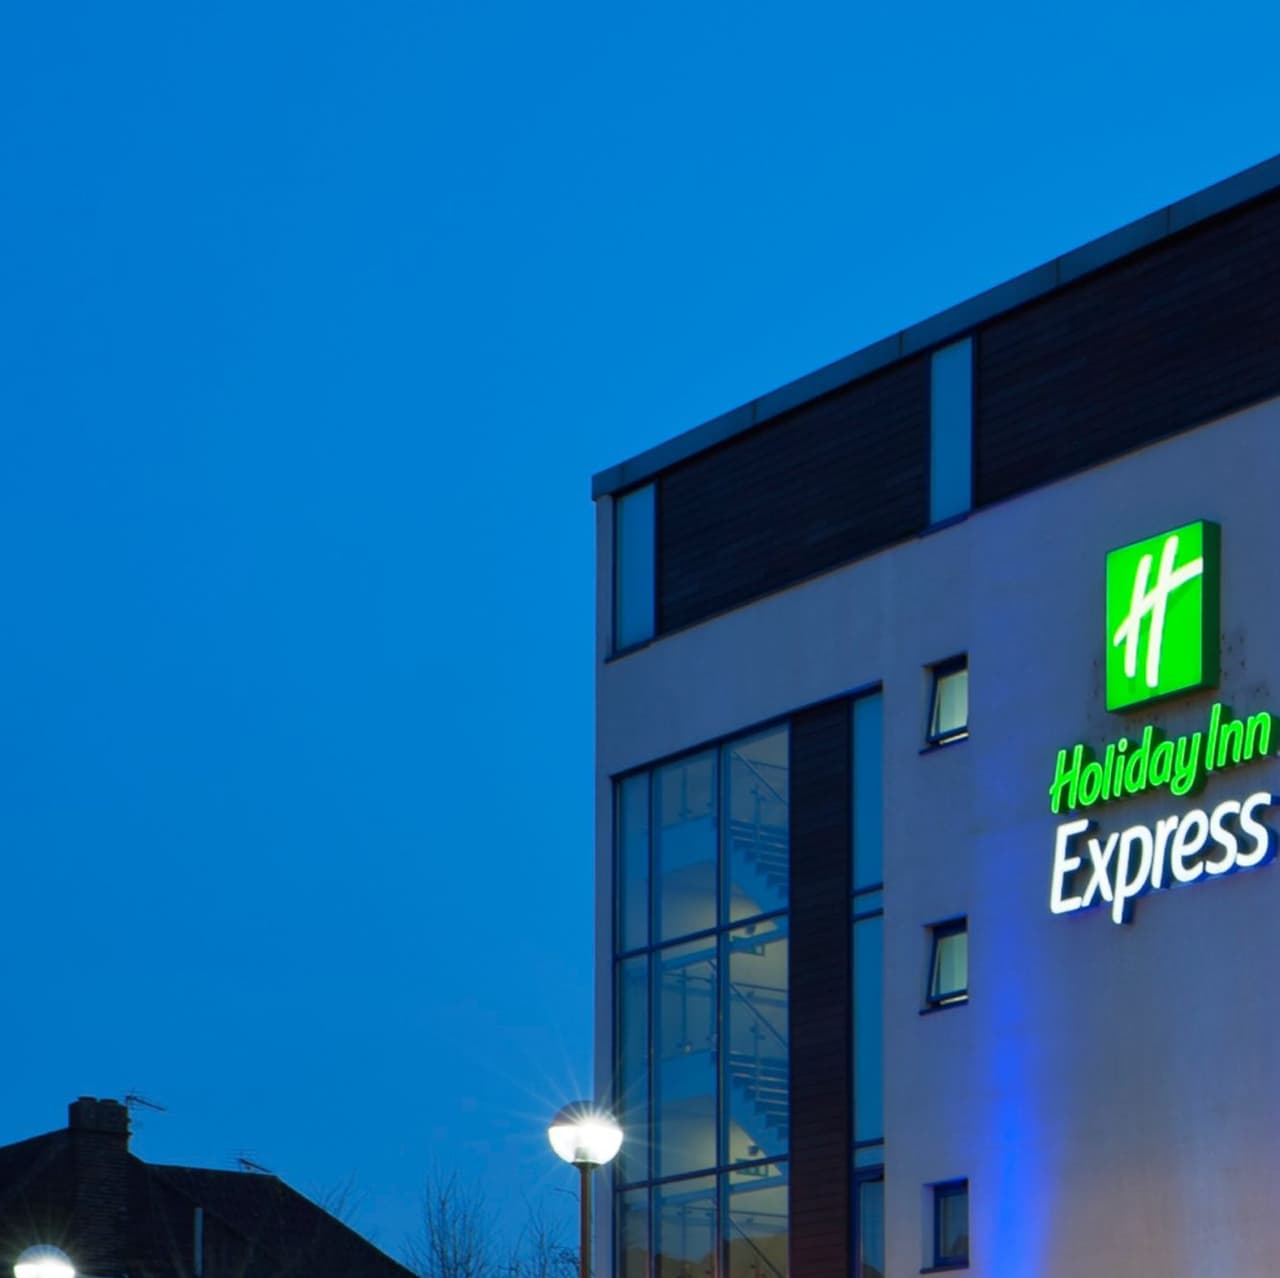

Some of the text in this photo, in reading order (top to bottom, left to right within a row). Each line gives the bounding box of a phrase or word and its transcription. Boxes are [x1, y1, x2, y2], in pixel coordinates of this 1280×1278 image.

[1050, 703, 1271, 814] Holiday Inn
[1050, 792, 1272, 925] Express
